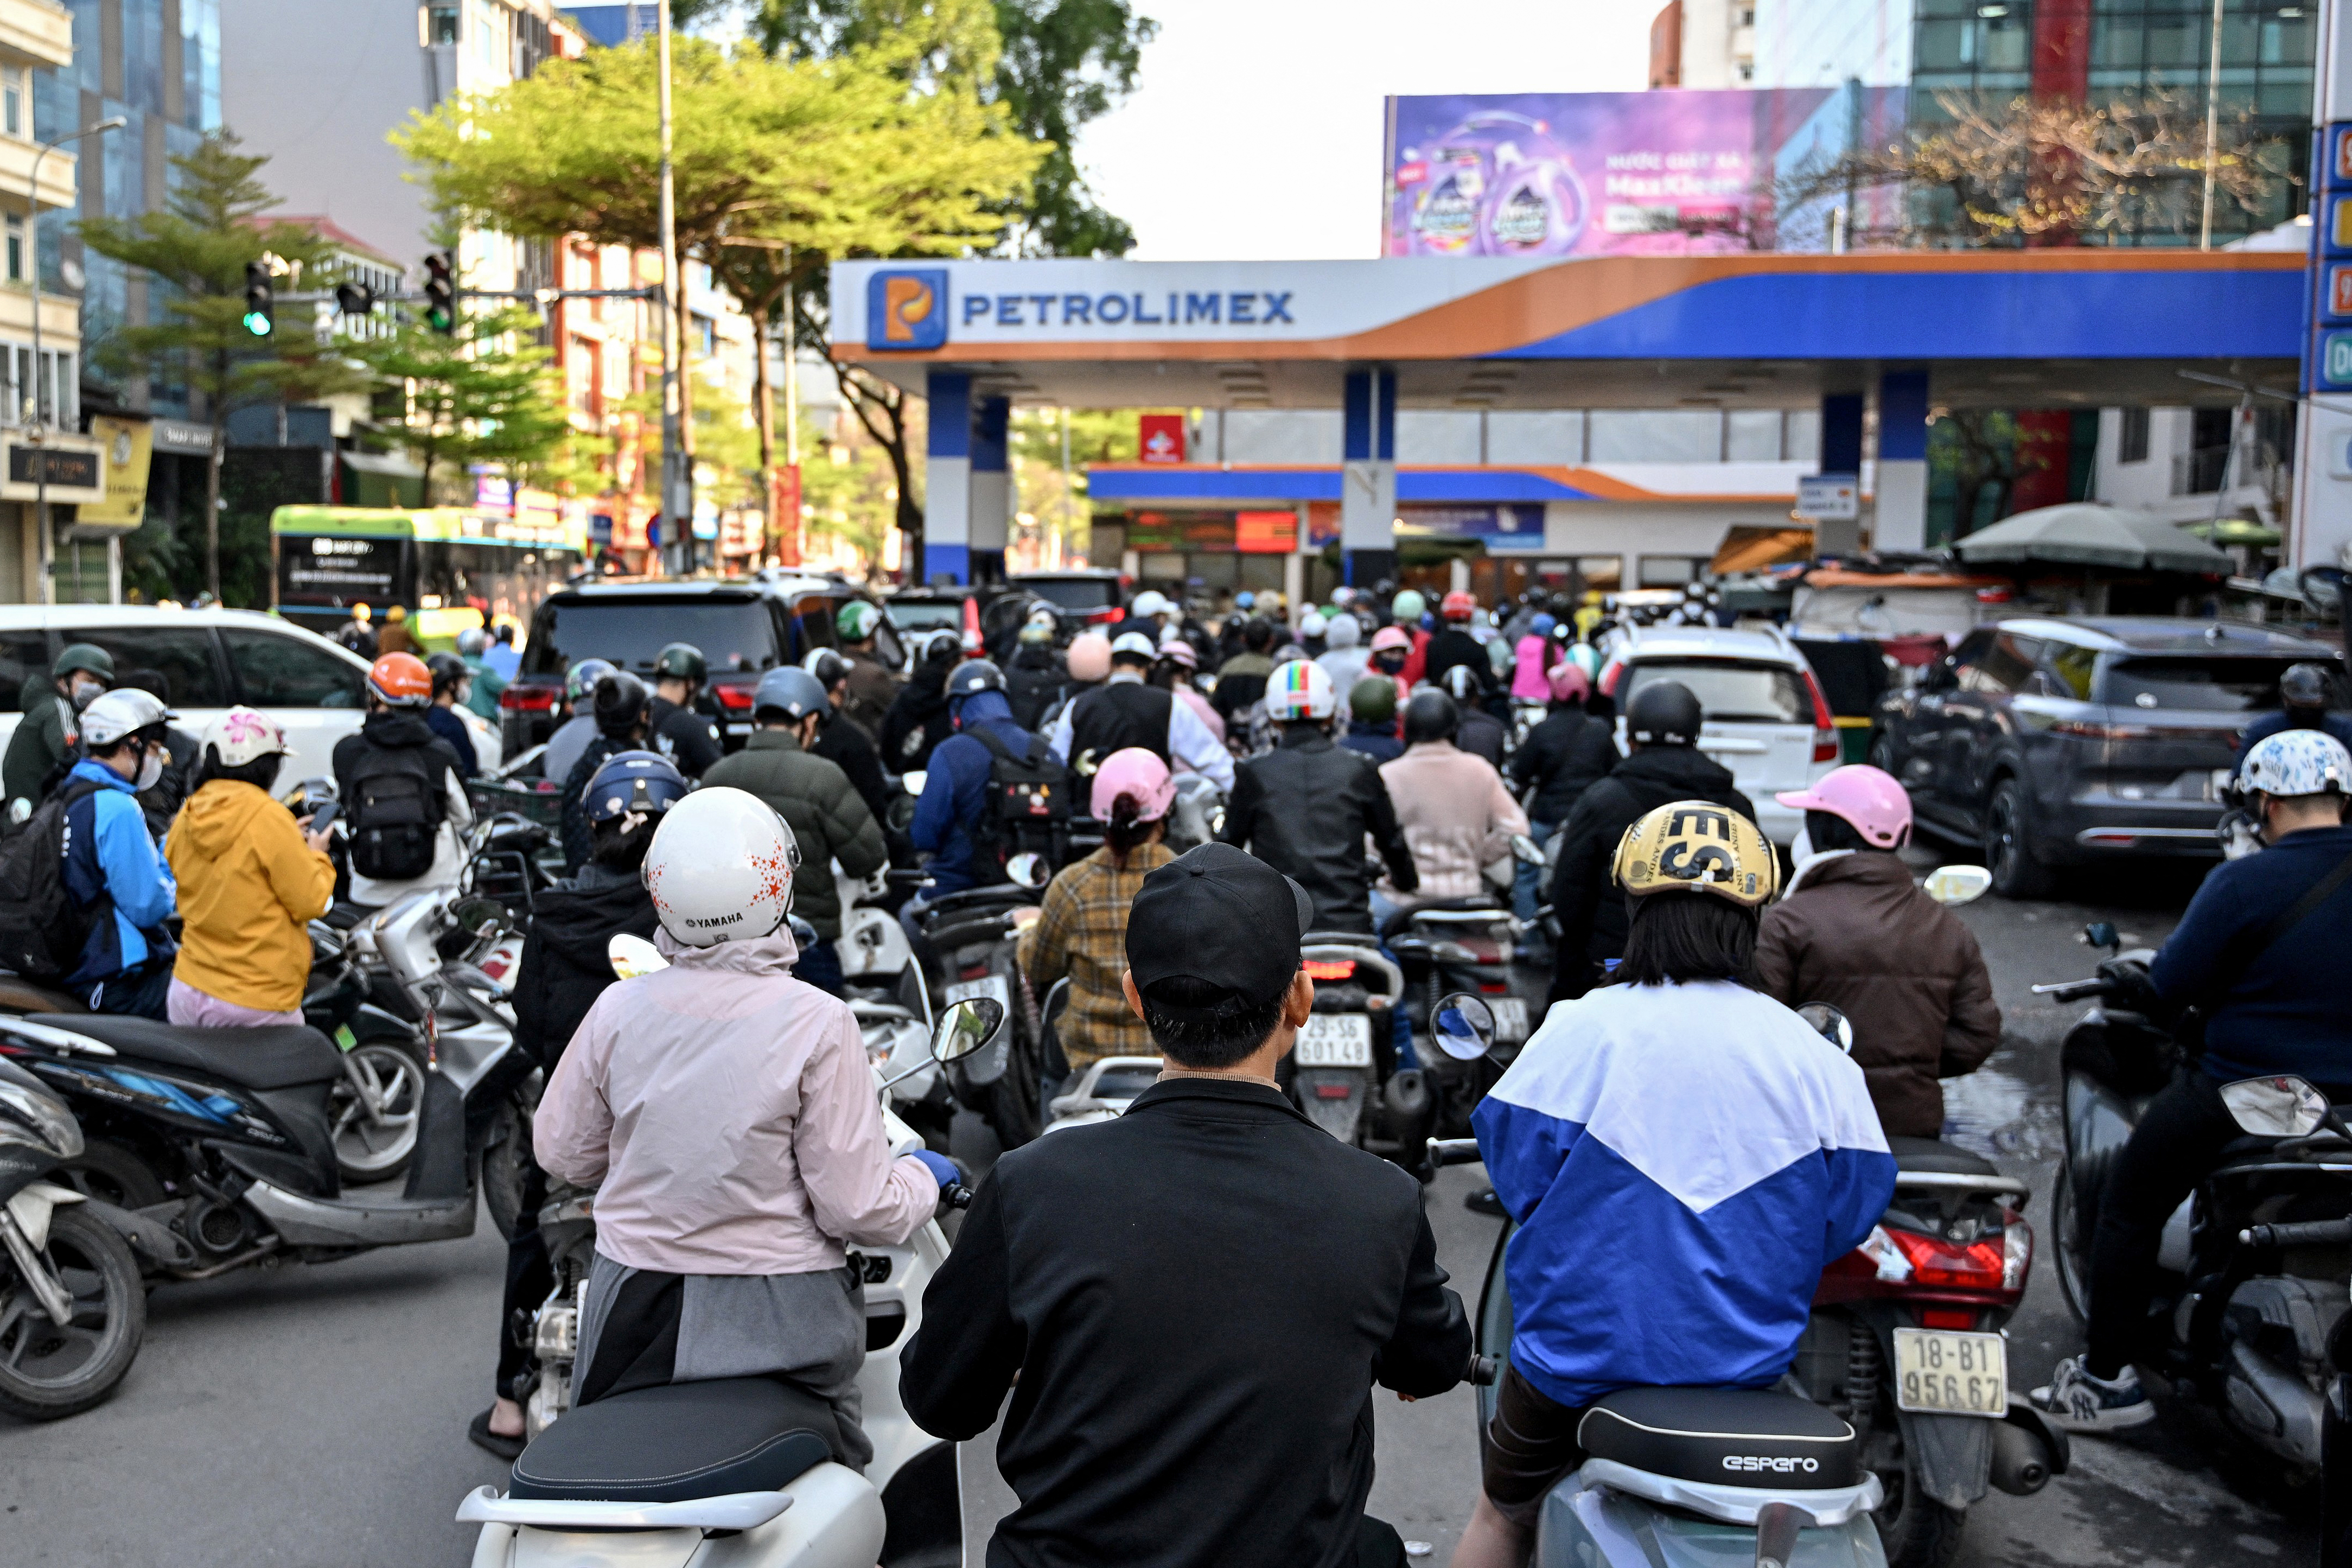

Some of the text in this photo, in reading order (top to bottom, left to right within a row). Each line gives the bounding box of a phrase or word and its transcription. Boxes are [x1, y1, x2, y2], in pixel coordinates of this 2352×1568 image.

[963, 292, 1293, 326] PETROLIMEX
[1646, 847, 1660, 883] ANDES
[697, 912, 743, 928] YAMAHA
[1914, 1335, 1986, 1371] 18-B1
